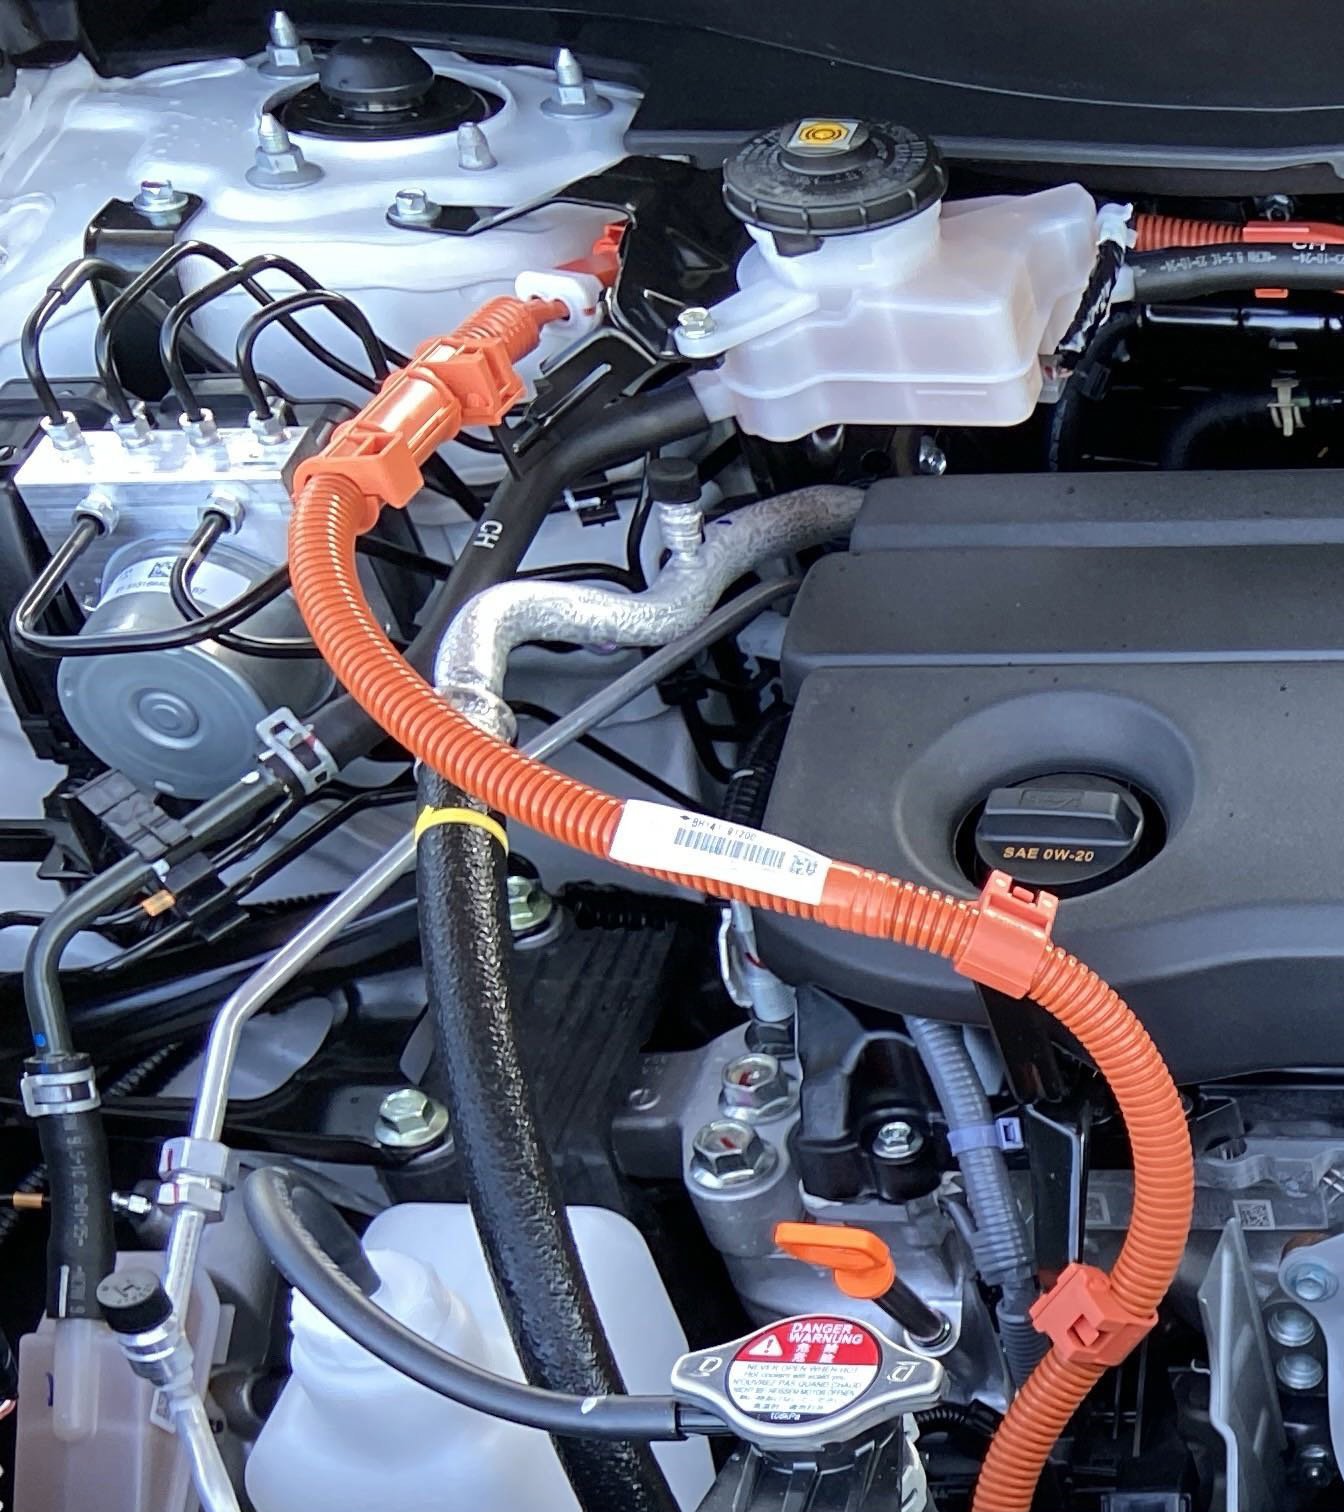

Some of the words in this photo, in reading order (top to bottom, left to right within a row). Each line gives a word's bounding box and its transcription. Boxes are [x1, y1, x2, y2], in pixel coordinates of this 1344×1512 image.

[1003, 847, 1040, 860] SAE
[1043, 849, 1095, 862] 0W-20
[791, 1323, 853, 1334] DANGER
